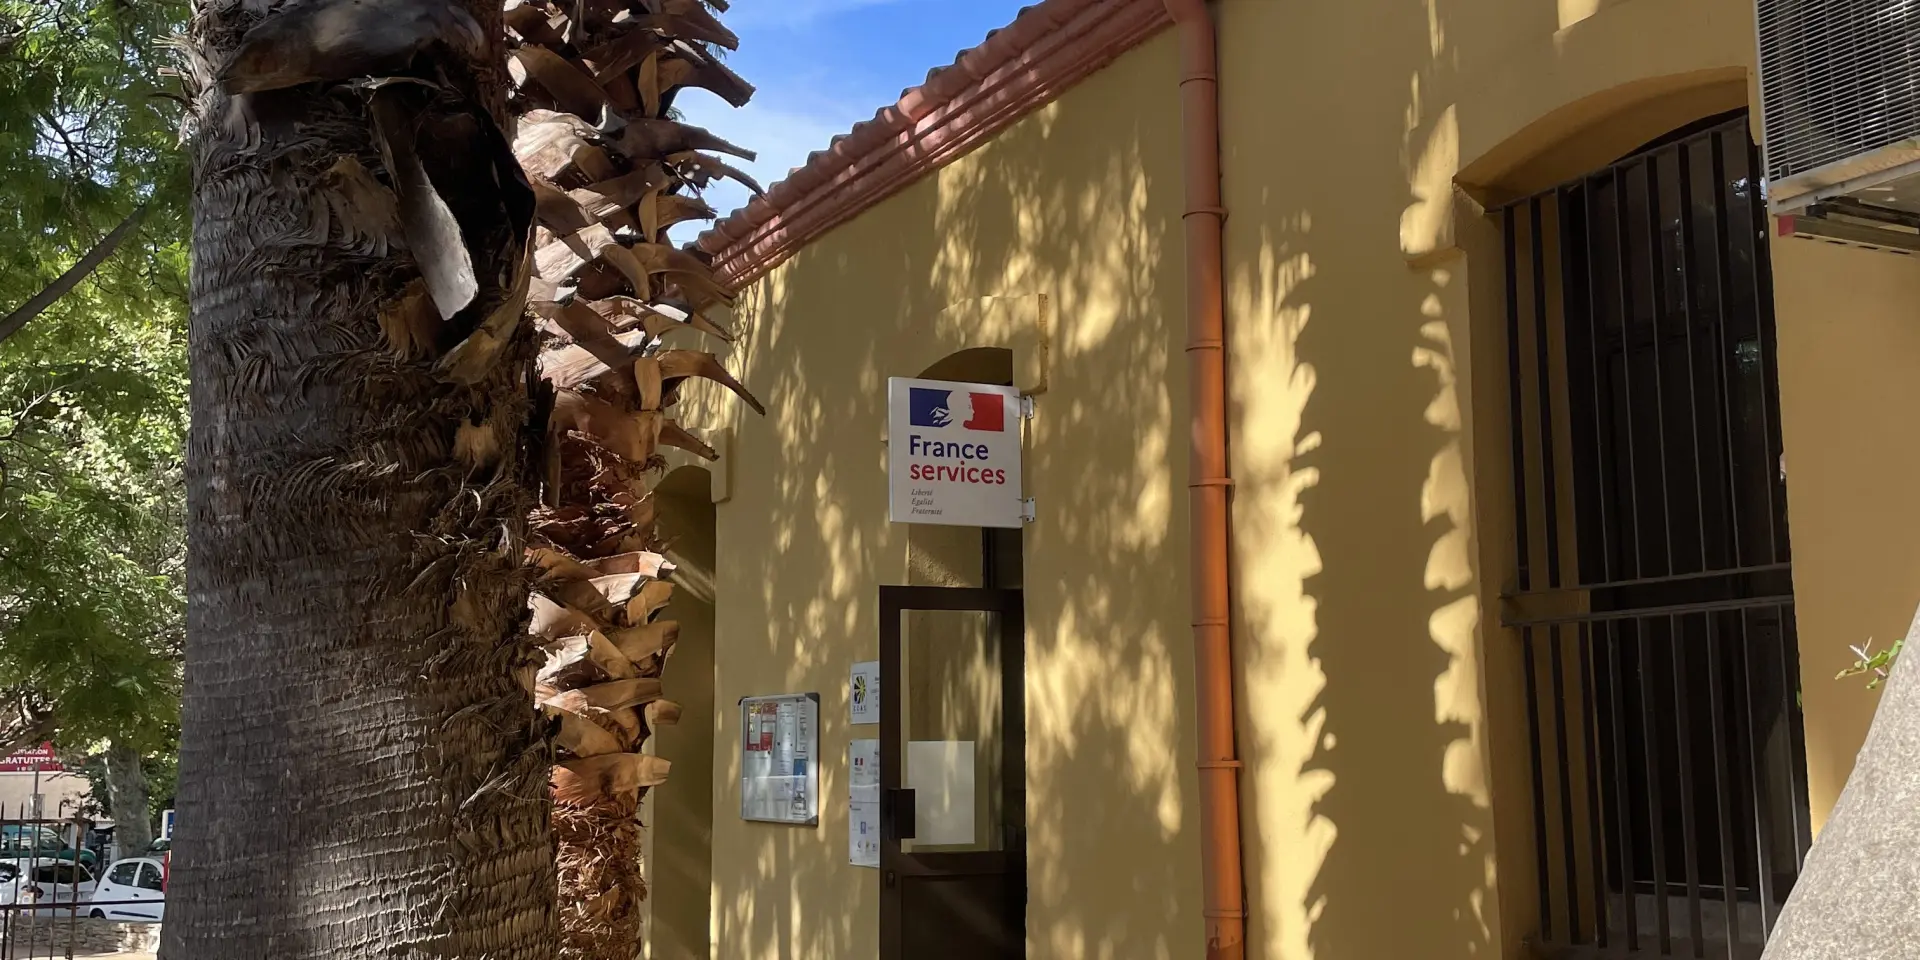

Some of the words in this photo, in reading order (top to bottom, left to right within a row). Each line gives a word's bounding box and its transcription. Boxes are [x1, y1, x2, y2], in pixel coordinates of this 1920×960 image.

[909, 434, 989, 460] France
[909, 460, 1006, 485] services
[911, 507, 942, 515] Fraternité
